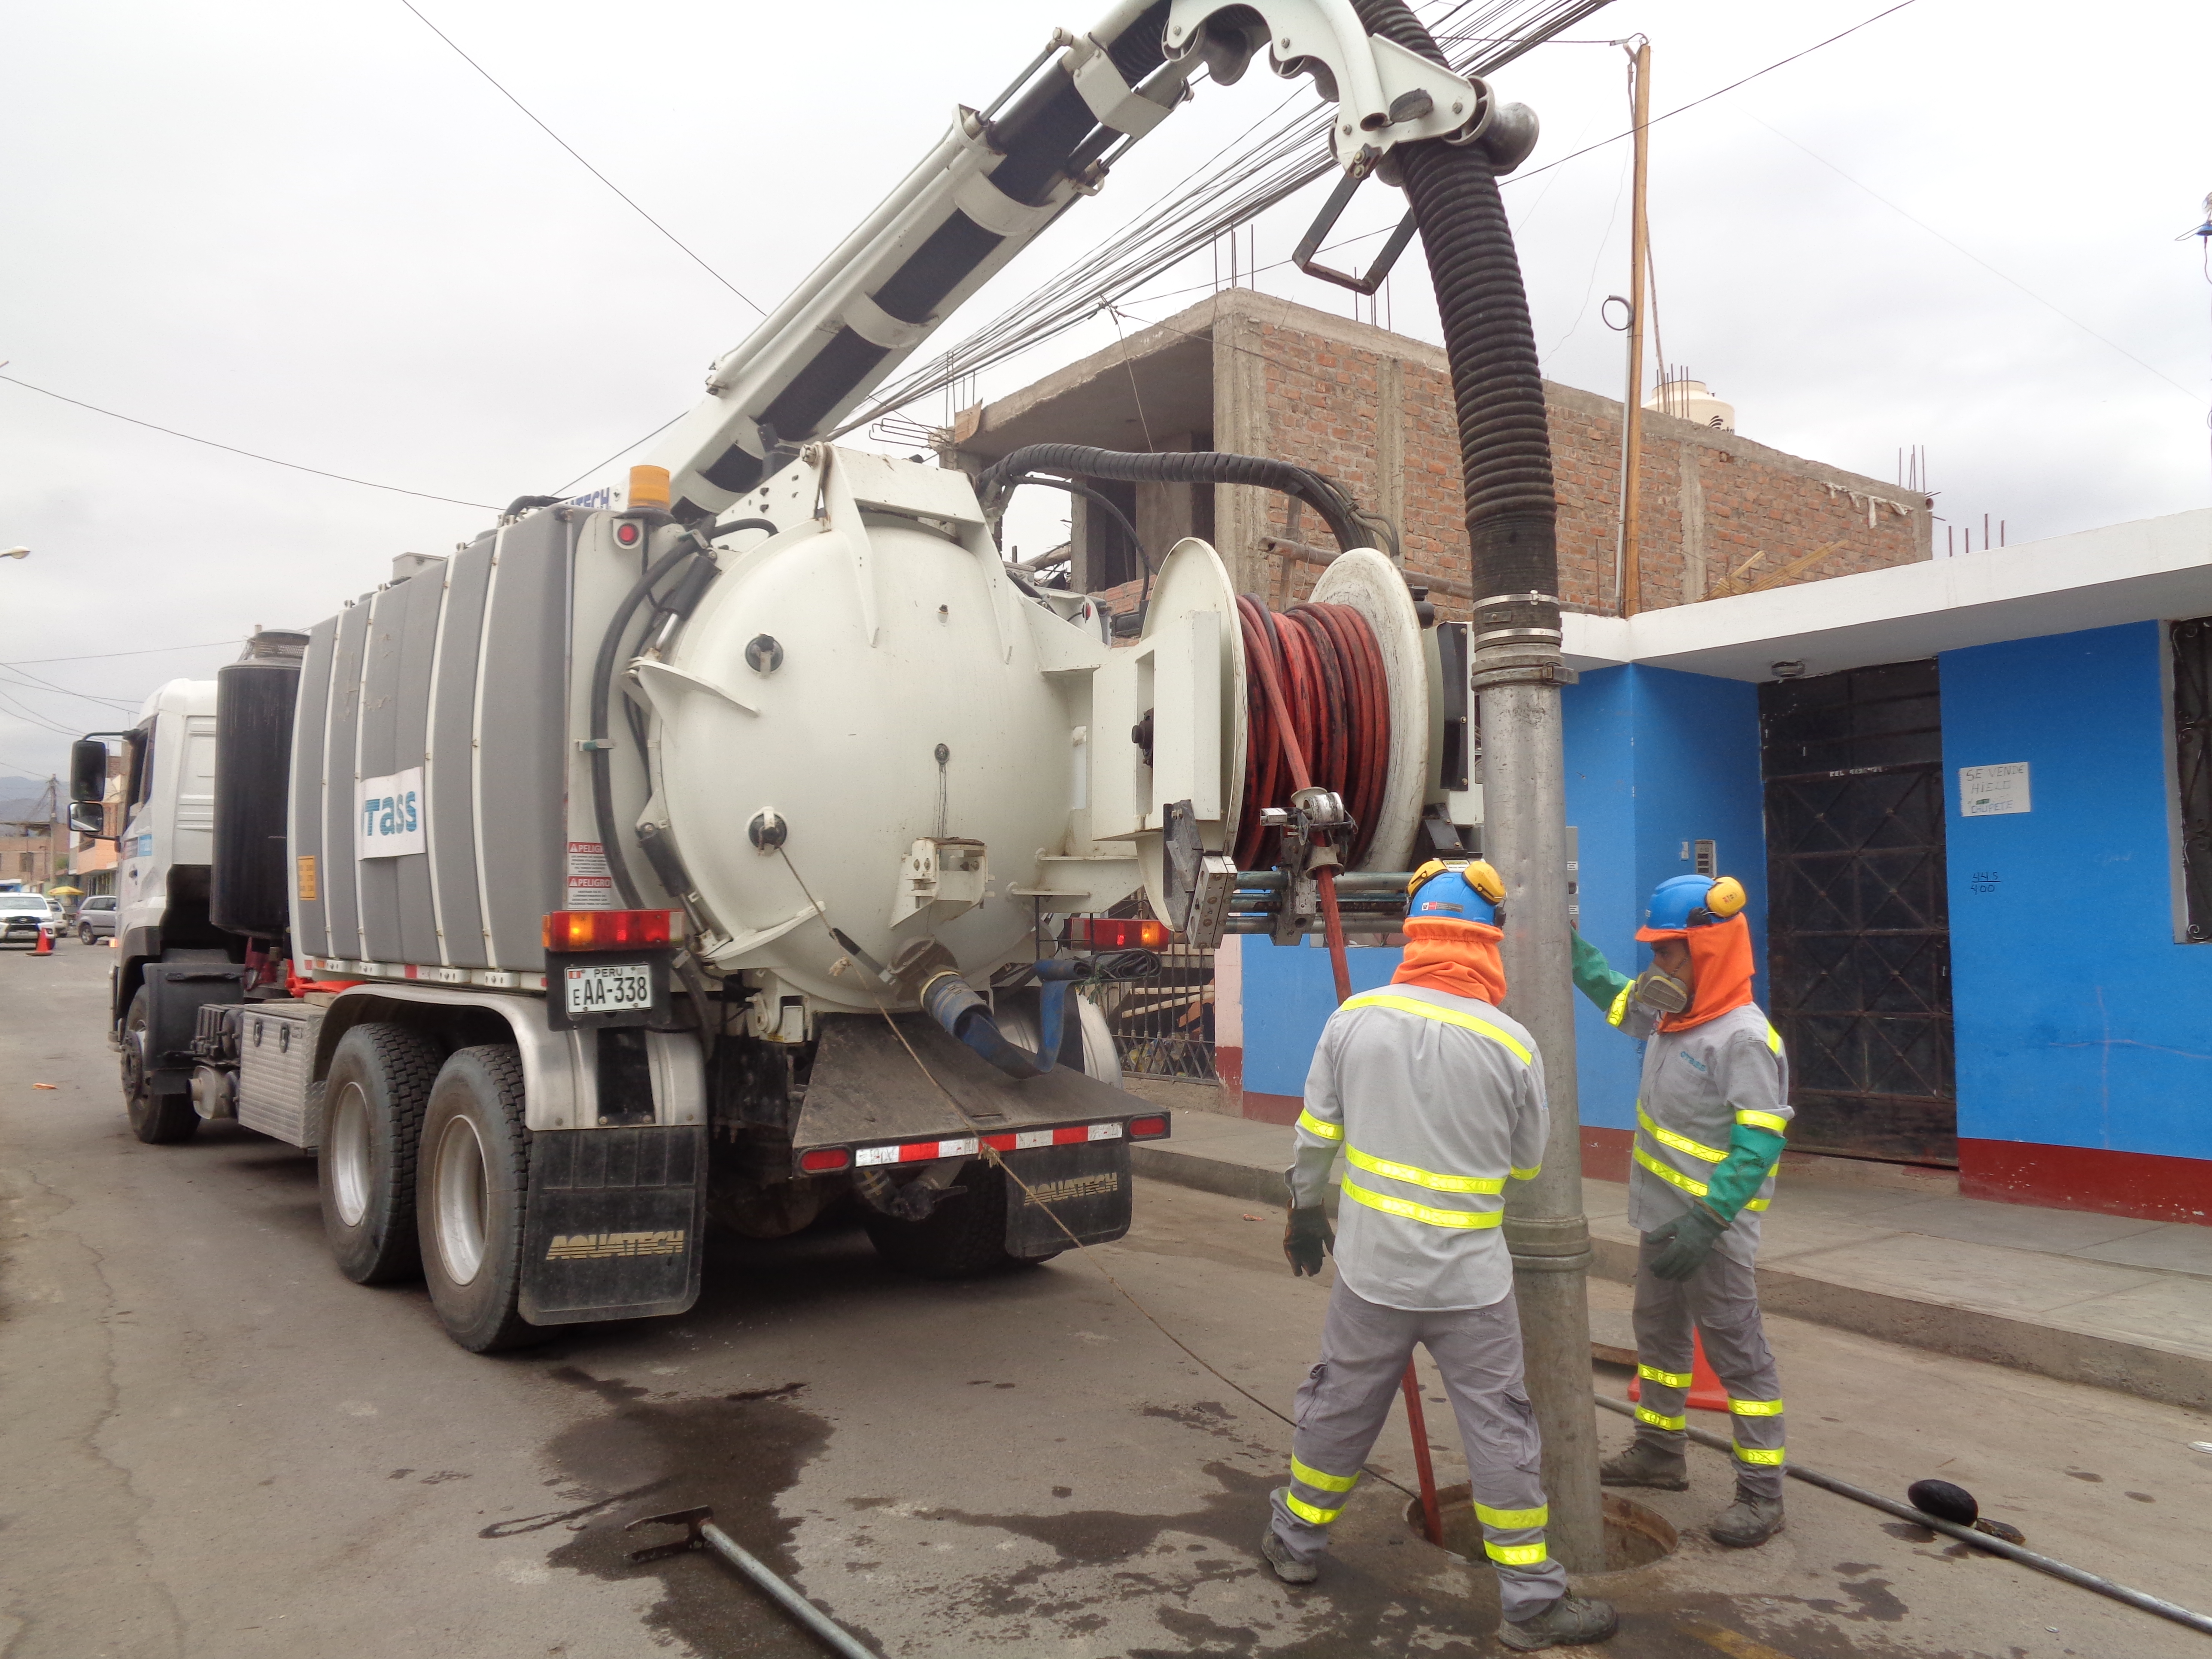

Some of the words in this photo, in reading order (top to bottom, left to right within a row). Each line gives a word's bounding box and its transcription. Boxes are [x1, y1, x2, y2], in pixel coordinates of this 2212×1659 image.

[1966, 769, 1983, 781] SE
[1988, 765, 2025, 777] VENDE
[578, 845, 602, 853] PELIG
[577, 878, 610, 887] PELIGRO
[1971, 884, 1995, 895] 400
[1024, 1172, 1118, 1206] AQUATECH
[546, 1230, 684, 1261] AQUATECH
